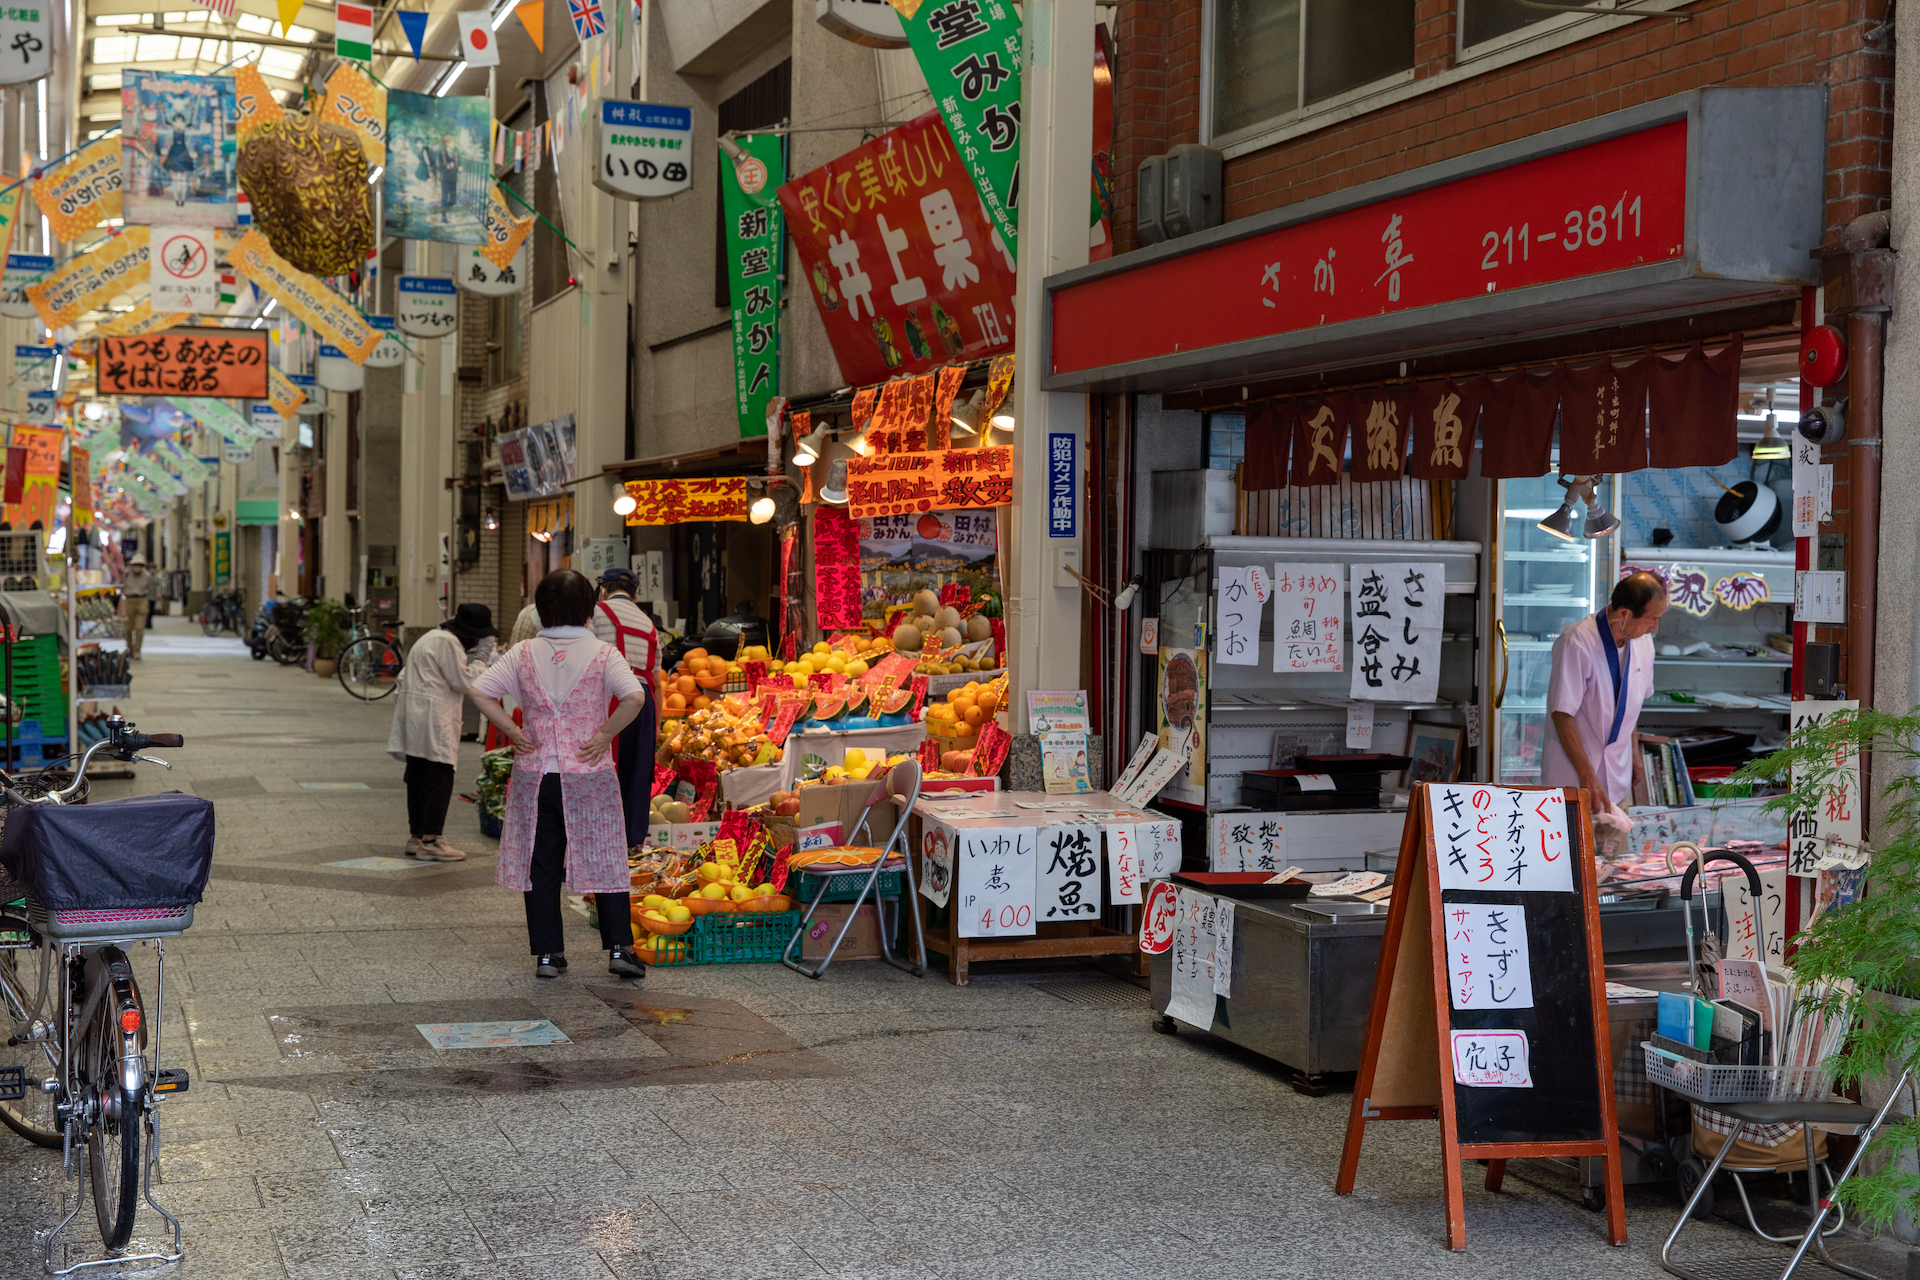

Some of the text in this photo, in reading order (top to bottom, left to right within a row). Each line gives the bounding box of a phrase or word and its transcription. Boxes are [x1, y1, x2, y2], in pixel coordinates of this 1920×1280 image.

[606, 153, 687, 182] いの田
[799, 124, 952, 234] 安くて美味しい
[942, 95, 1018, 239] 新堂みかん出荷組合
[1481, 195, 1642, 271] 211-3811
[1261, 213, 1414, 308] さが喜
[401, 311, 454, 327] いづもや
[107, 361, 219, 391] そばにある
[942, 449, 1010, 473] 新鮮
[848, 477, 937, 505] 老化防止
[937, 475, 1012, 505] 激安
[1053, 437, 1072, 531] 防犯カメラ作動中
[686, 498, 747, 519] 老化防止
[955, 516, 991, 534] 田村
[1250, 570, 1265, 604] たたき
[1281, 571, 1337, 595] おすすめ
[1224, 579, 1248, 656] かつお
[1303, 597, 1316, 617] 旬
[1286, 619, 1317, 640] 鯛
[1356, 570, 1392, 688] 盛合せ
[1391, 567, 1424, 684] さしみ
[1288, 644, 1321, 659] たい
[968, 833, 1031, 858] いわし
[1443, 788, 1471, 875] キンキ
[1472, 789, 1498, 883] のどぐろ
[1504, 790, 1528, 885] マナガツオ
[1535, 795, 1562, 862] ぐじ
[1118, 830, 1137, 897] うなぎ
[1150, 824, 1164, 873] そうめん
[984, 864, 1010, 894] 煮
[1046, 829, 1097, 918] 焼魚
[811, 922, 827, 939] Oriji
[981, 904, 1031, 929] 400
[1176, 900, 1186, 972] うなぎ
[1452, 909, 1474, 1004] サバとアジ
[1487, 910, 1518, 1003] きずし
[1725, 982, 1756, 995] 交流ノート
[1465, 1042, 1515, 1072] 穴子
